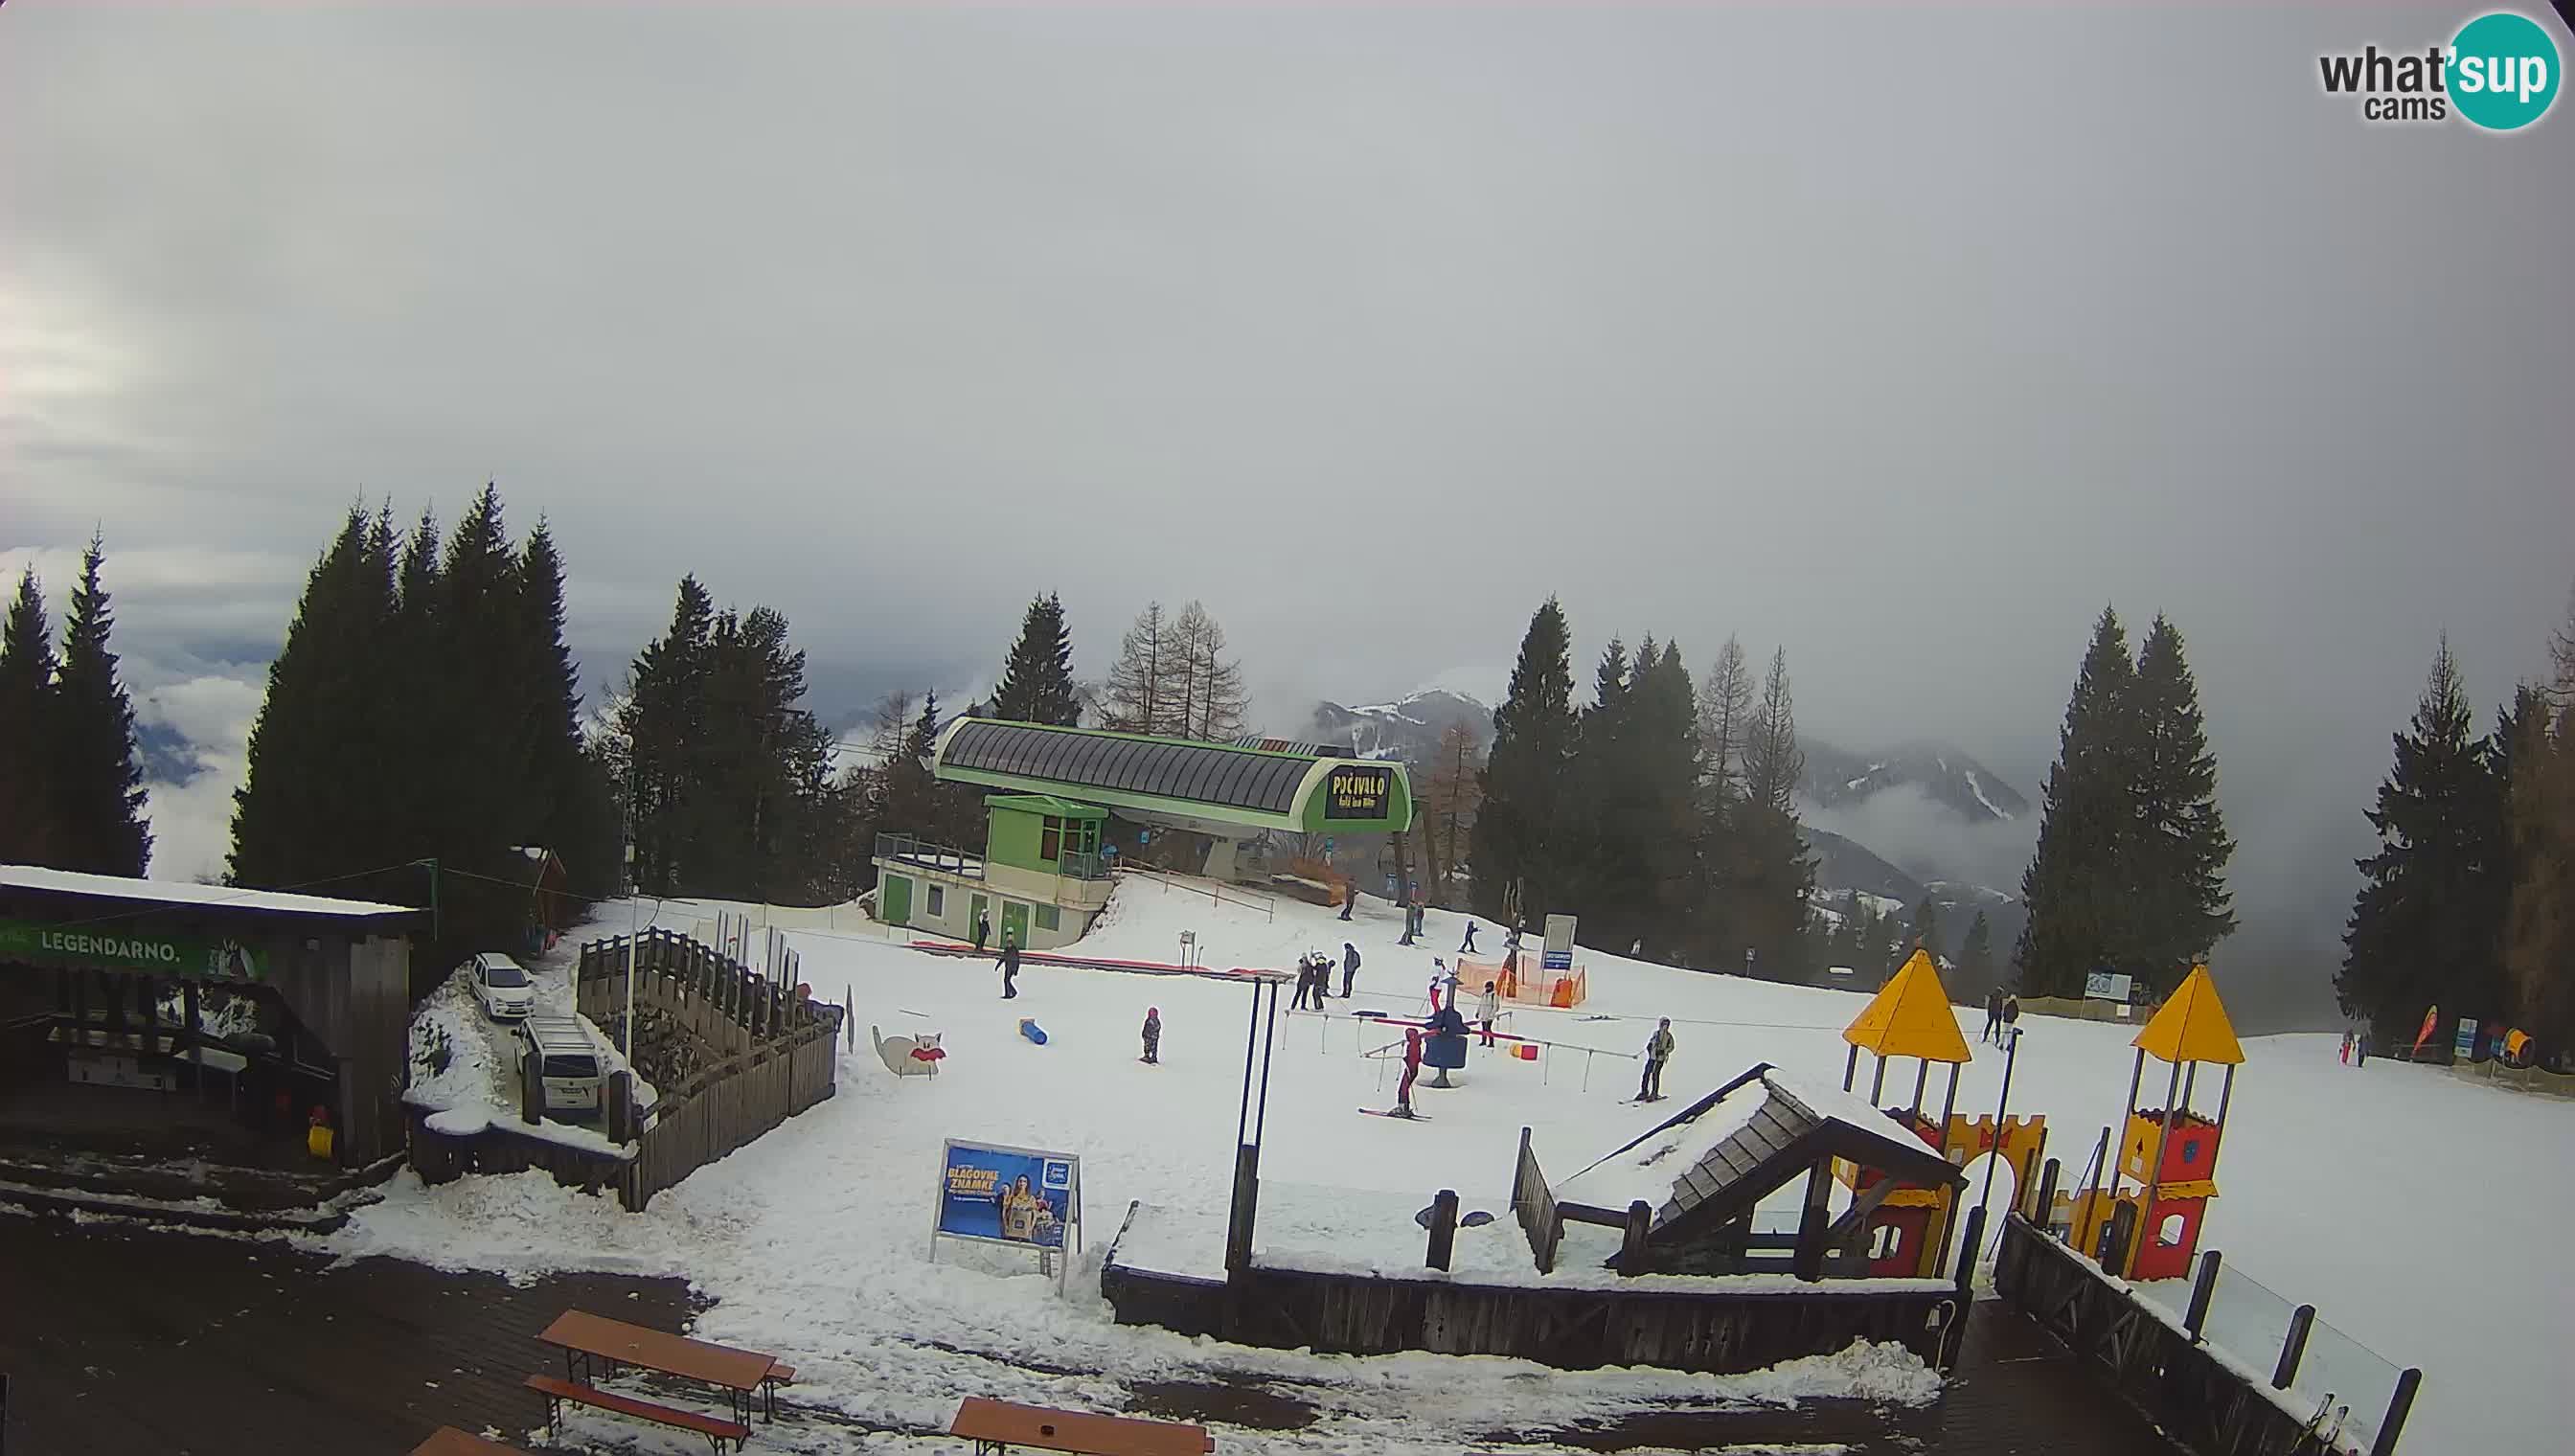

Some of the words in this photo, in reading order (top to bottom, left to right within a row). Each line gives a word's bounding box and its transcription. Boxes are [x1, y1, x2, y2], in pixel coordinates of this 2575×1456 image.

[41, 931, 181, 963] LEGENDARNO.
[947, 1168, 1000, 1181] BLAGOVNE
[949, 1178, 996, 1192] ZNAMKE
